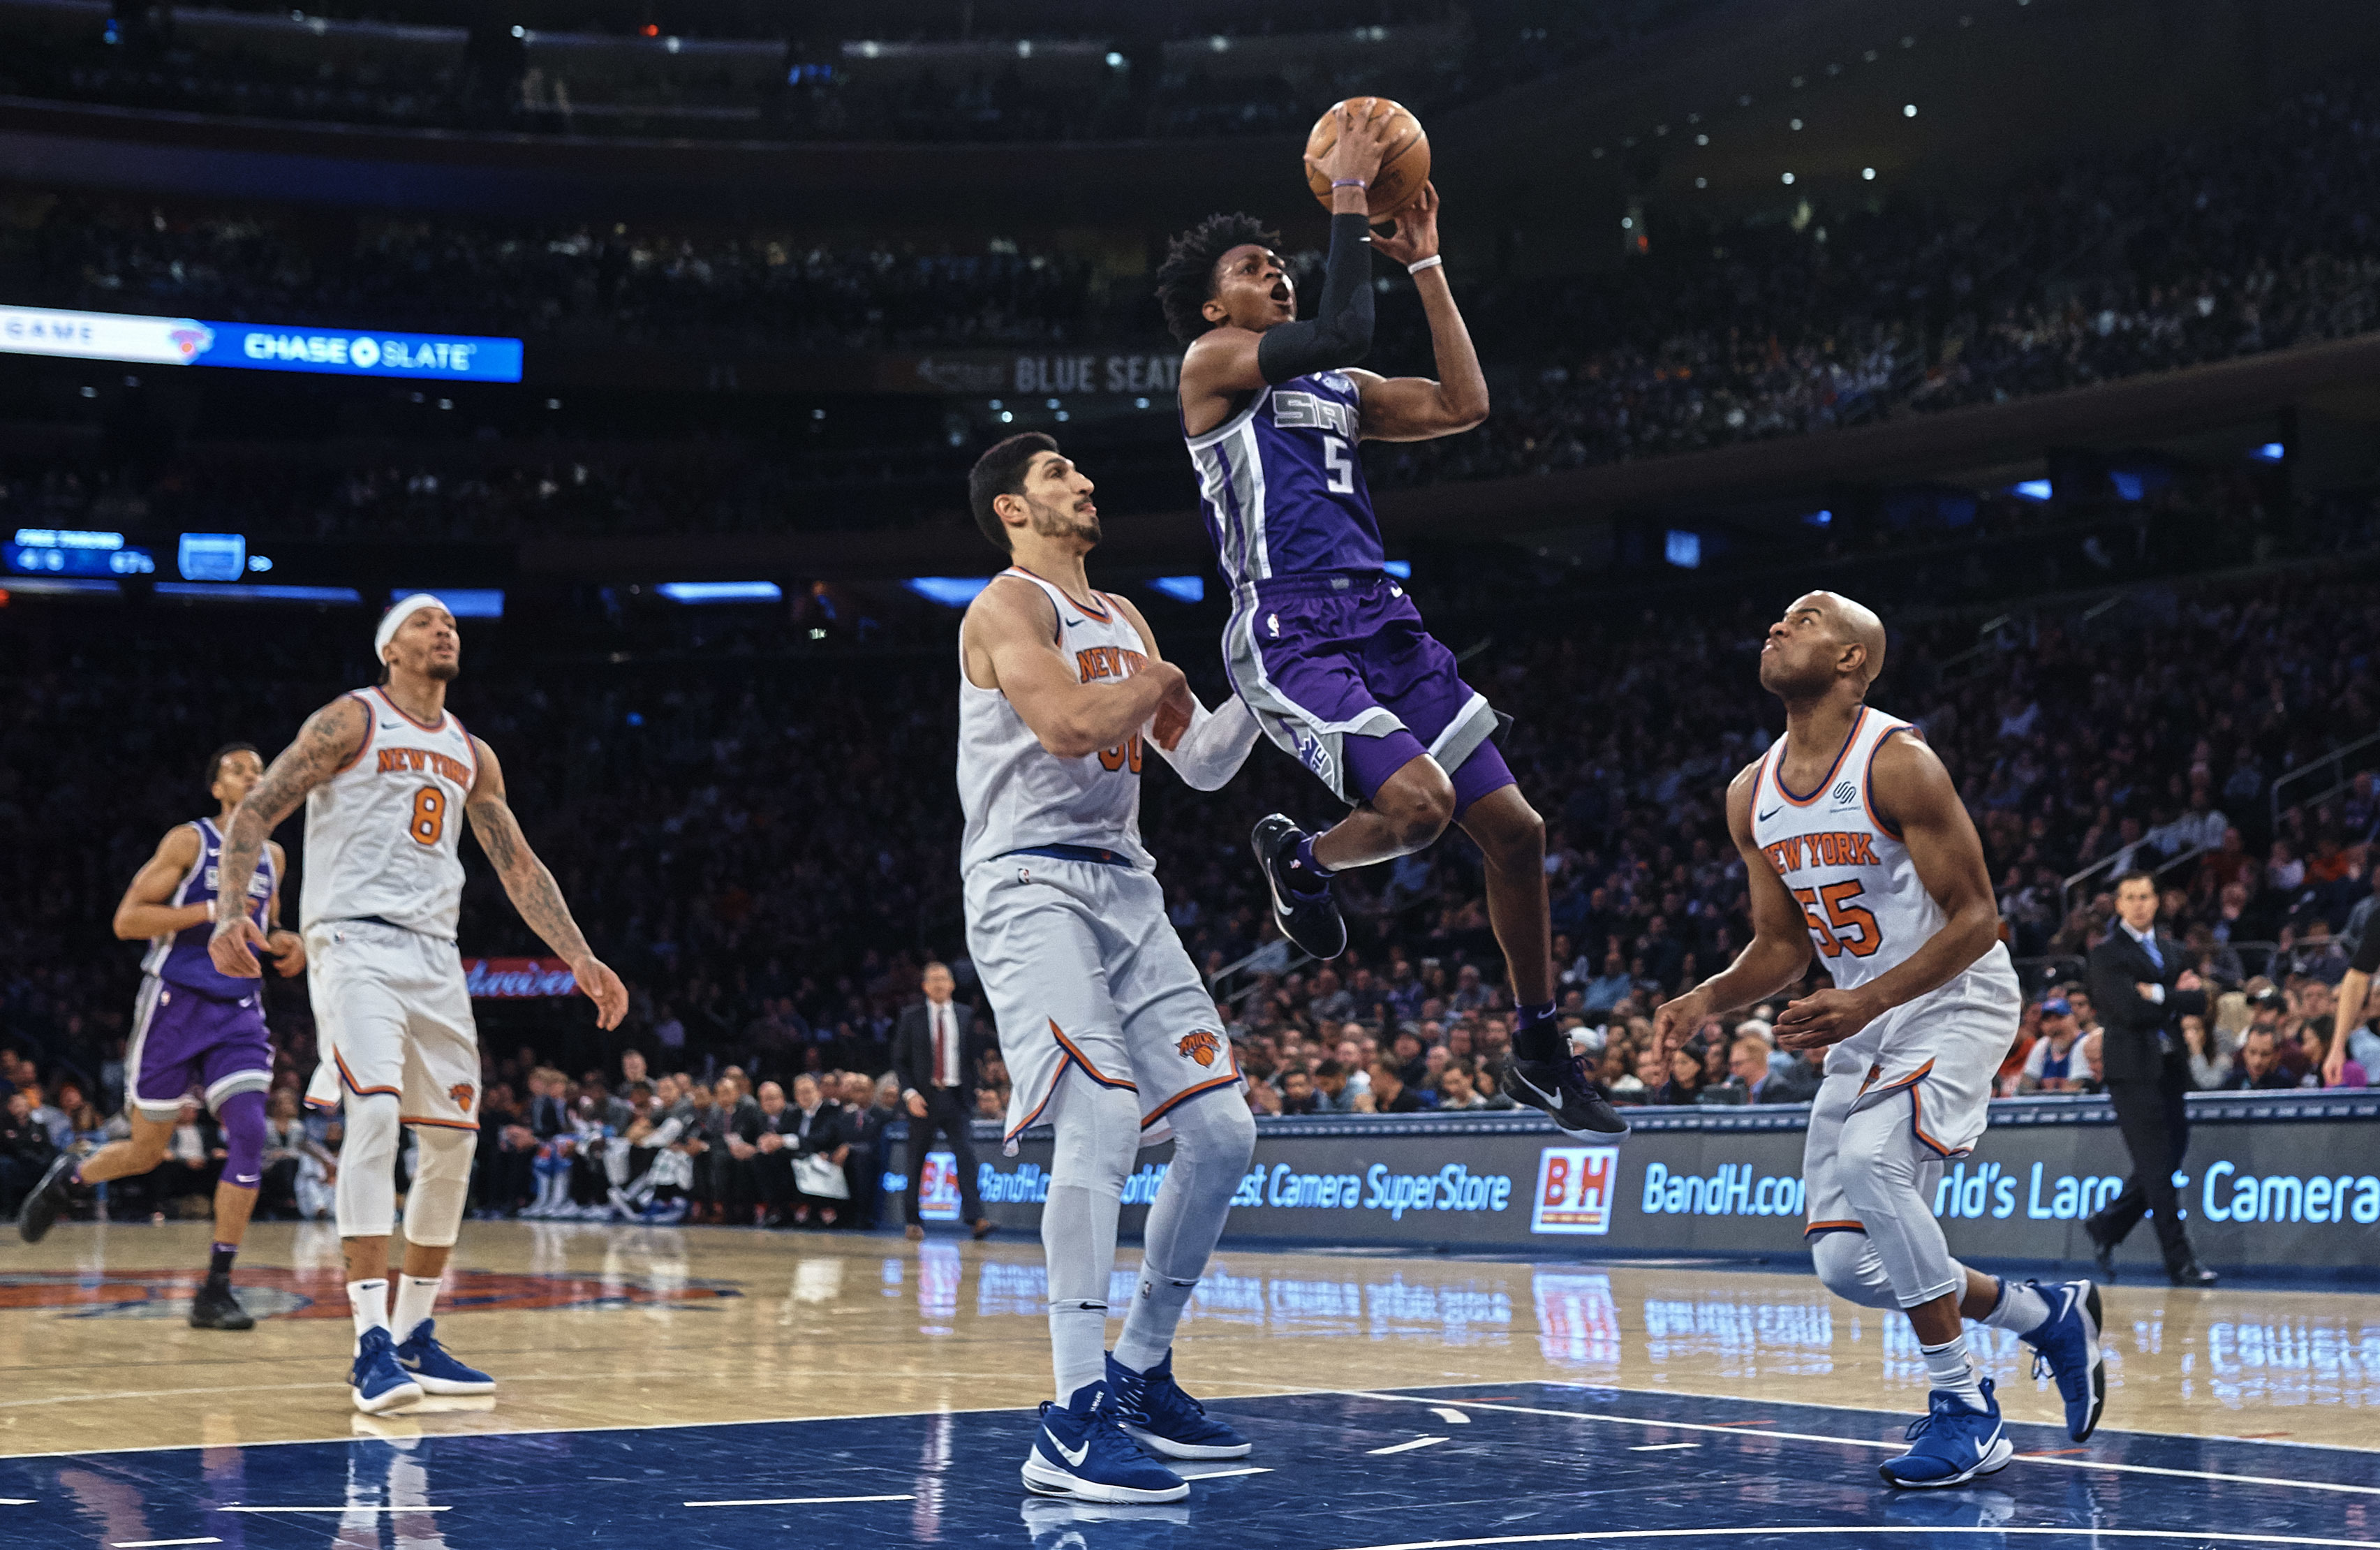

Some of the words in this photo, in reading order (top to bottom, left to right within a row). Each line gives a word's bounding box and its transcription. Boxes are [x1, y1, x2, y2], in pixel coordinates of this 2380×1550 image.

[244, 332, 348, 364] CHASE
[379, 338, 471, 371] SLATE
[1014, 357, 1097, 393] BLUE
[1105, 355, 1181, 393] SEAT
[1324, 435, 1354, 494] 5
[1076, 646, 1123, 684] NEW
[377, 747, 425, 774] NEW
[410, 786, 446, 846] 8
[1804, 832, 1880, 867] YORK
[1792, 878, 1883, 959] 55
[1269, 1163, 1361, 1209] Camera
[1363, 1163, 1511, 1220] SuperStore
[1933, 1162, 2017, 1219] rld's
[2203, 1160, 2380, 1223] Camera
